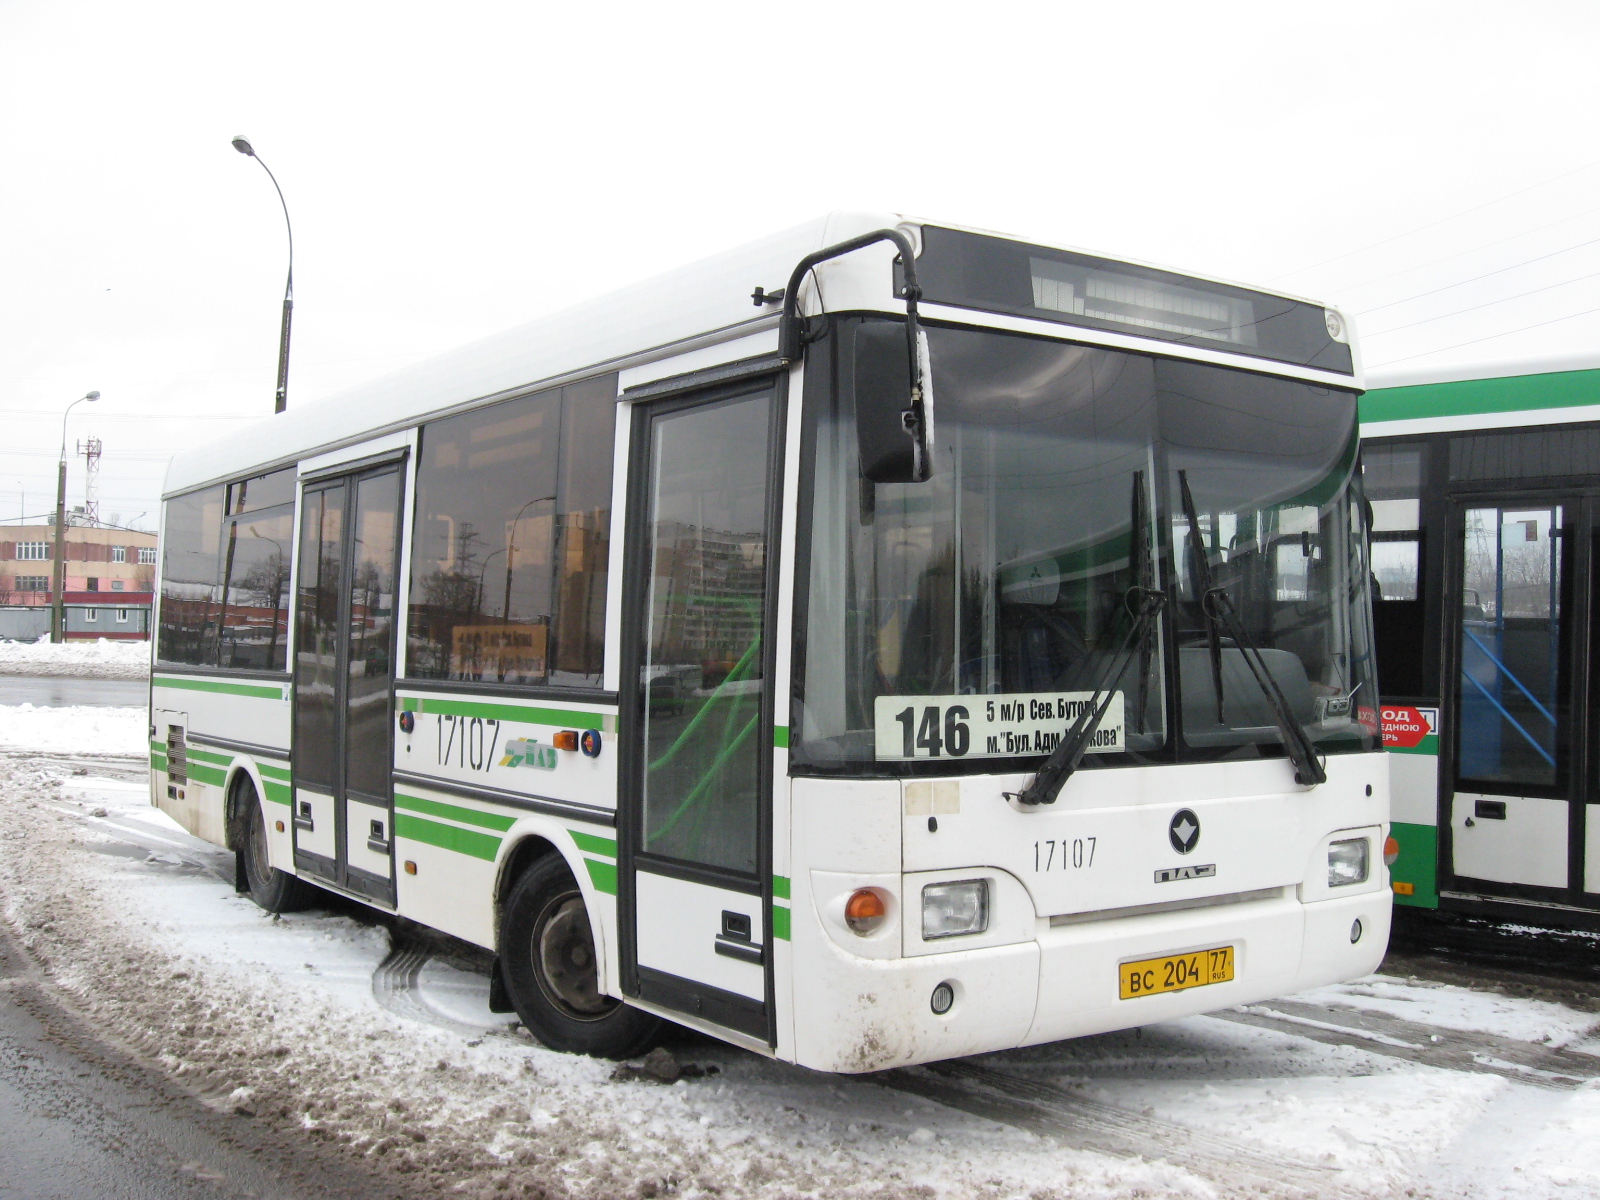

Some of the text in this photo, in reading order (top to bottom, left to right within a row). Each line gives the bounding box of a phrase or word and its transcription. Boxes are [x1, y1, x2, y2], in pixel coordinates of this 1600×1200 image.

[986, 700, 995, 722] 5
[1000, 699, 1025, 722] м/р
[437, 714, 500, 773] 17107
[895, 704, 970, 758] 146
[1034, 836, 1097, 873] 17107
[1163, 956, 1199, 988] 204
[1210, 950, 1228, 972] 77
[1212, 971, 1226, 980] RUS
